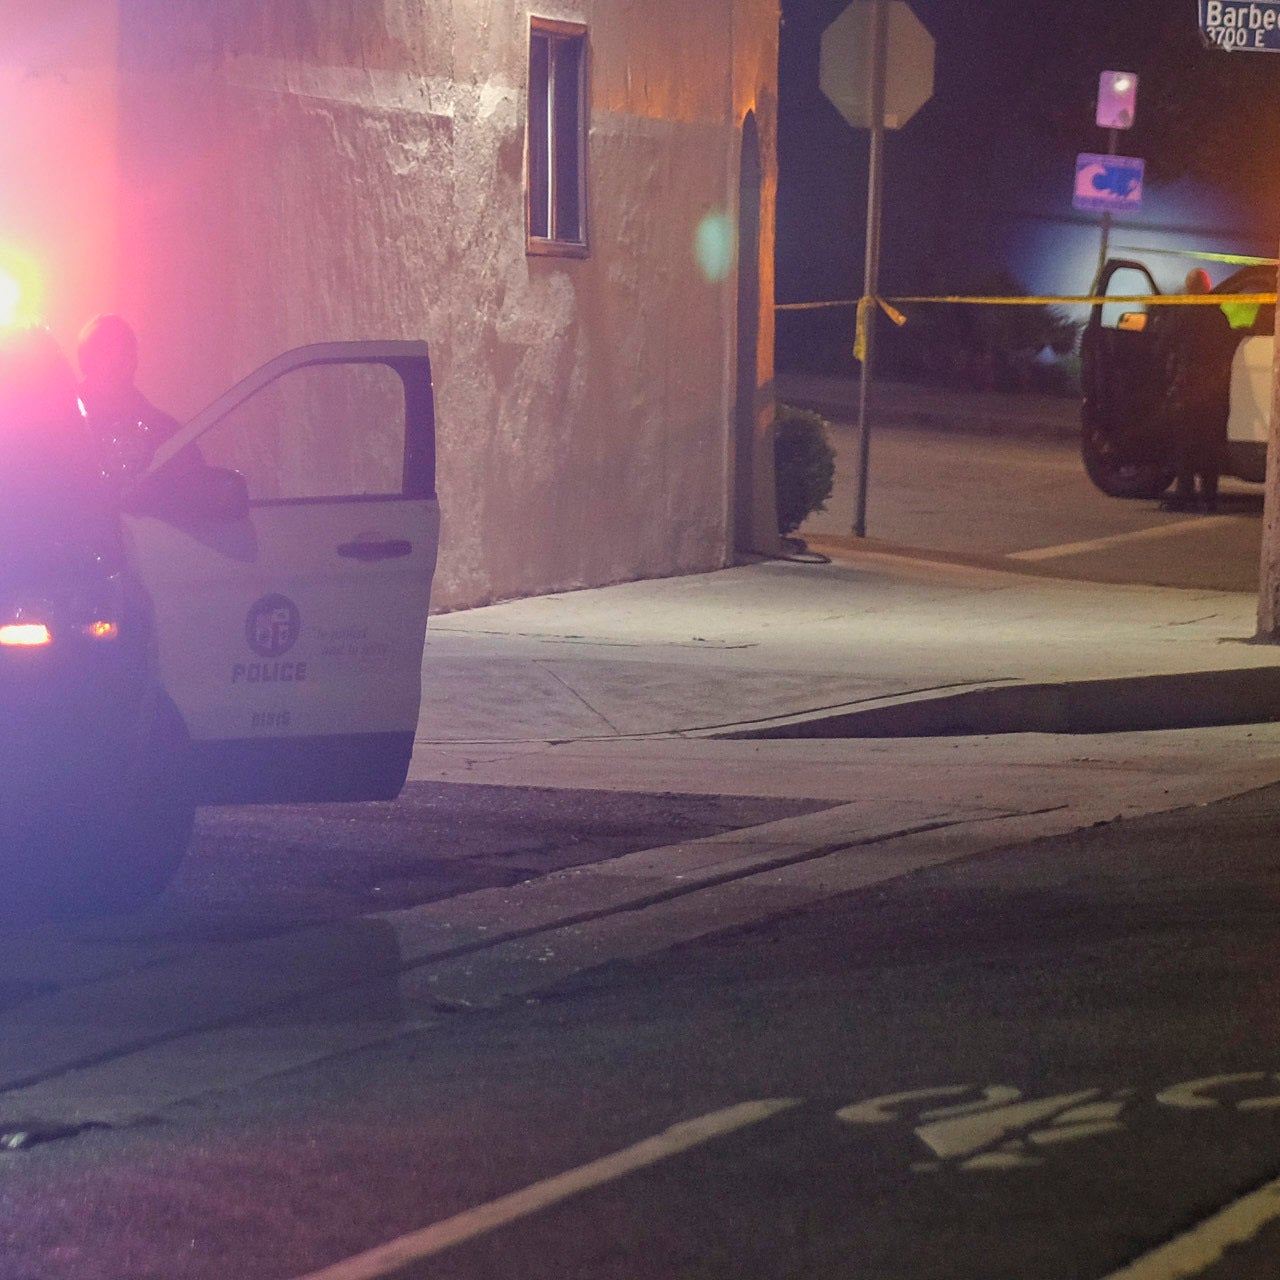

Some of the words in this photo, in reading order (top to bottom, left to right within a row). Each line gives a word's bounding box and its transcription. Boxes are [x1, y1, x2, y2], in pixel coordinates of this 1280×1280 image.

[1206, 26, 1248, 47] 3700
[1254, 29, 1266, 47] E
[231, 661, 307, 684] POLICE
